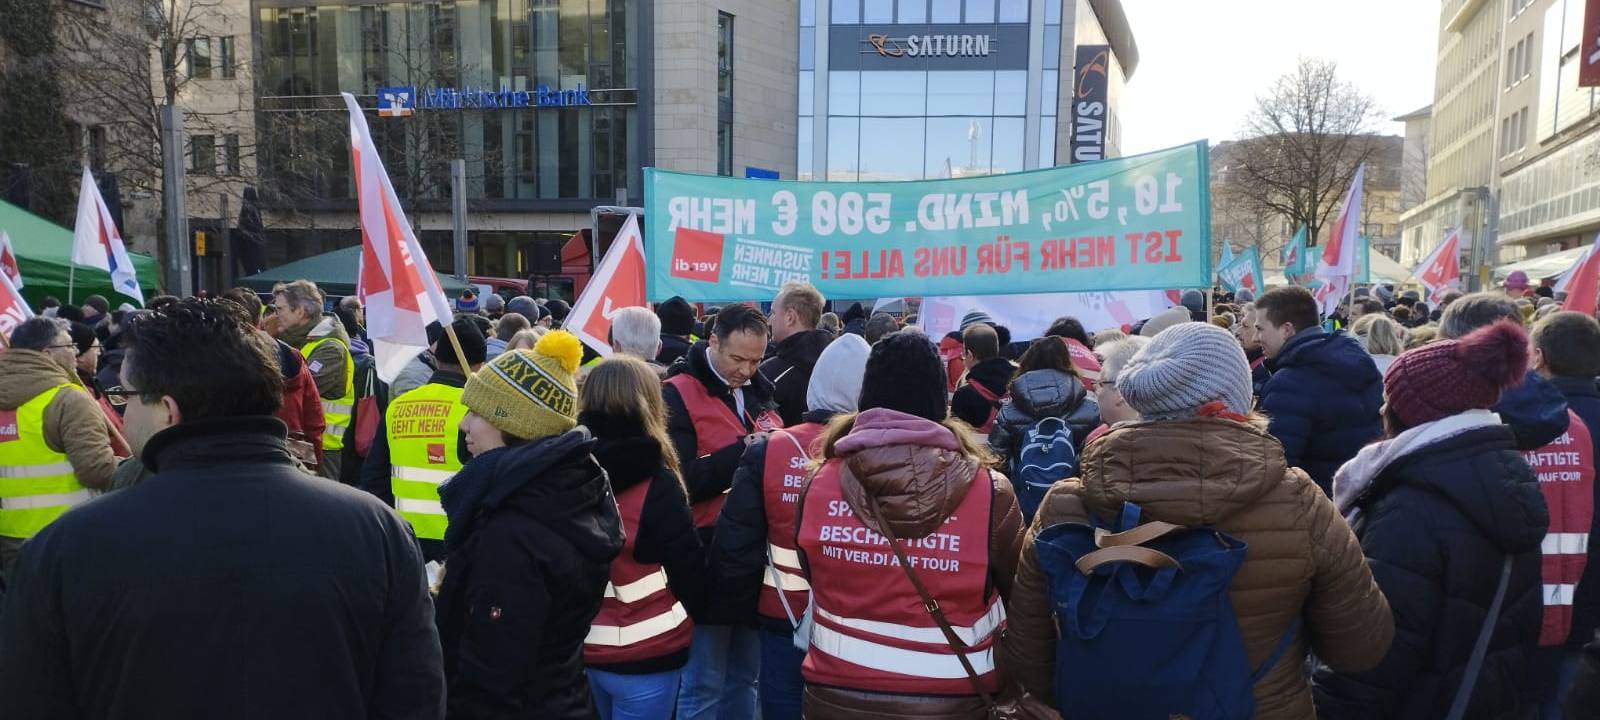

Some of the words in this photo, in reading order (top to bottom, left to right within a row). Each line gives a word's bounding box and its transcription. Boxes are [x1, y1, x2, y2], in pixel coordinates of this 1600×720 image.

[907, 34, 990, 56] SATURN
[424, 84, 530, 108] Märkische
[536, 82, 592, 106] Bank
[495, 353, 540, 385] BAY
[393, 404, 452, 419] ZUSAMMEN
[392, 420, 416, 434] GEHT
[418, 419, 447, 433] MEHR
[1537, 472, 1559, 482] AUF
[1559, 471, 1582, 481] OUR
[819, 525, 960, 552] BESCHIGTE
[823, 545, 843, 559] MIT
[844, 549, 888, 566] VER.DI
[920, 557, 960, 572] TOUR
